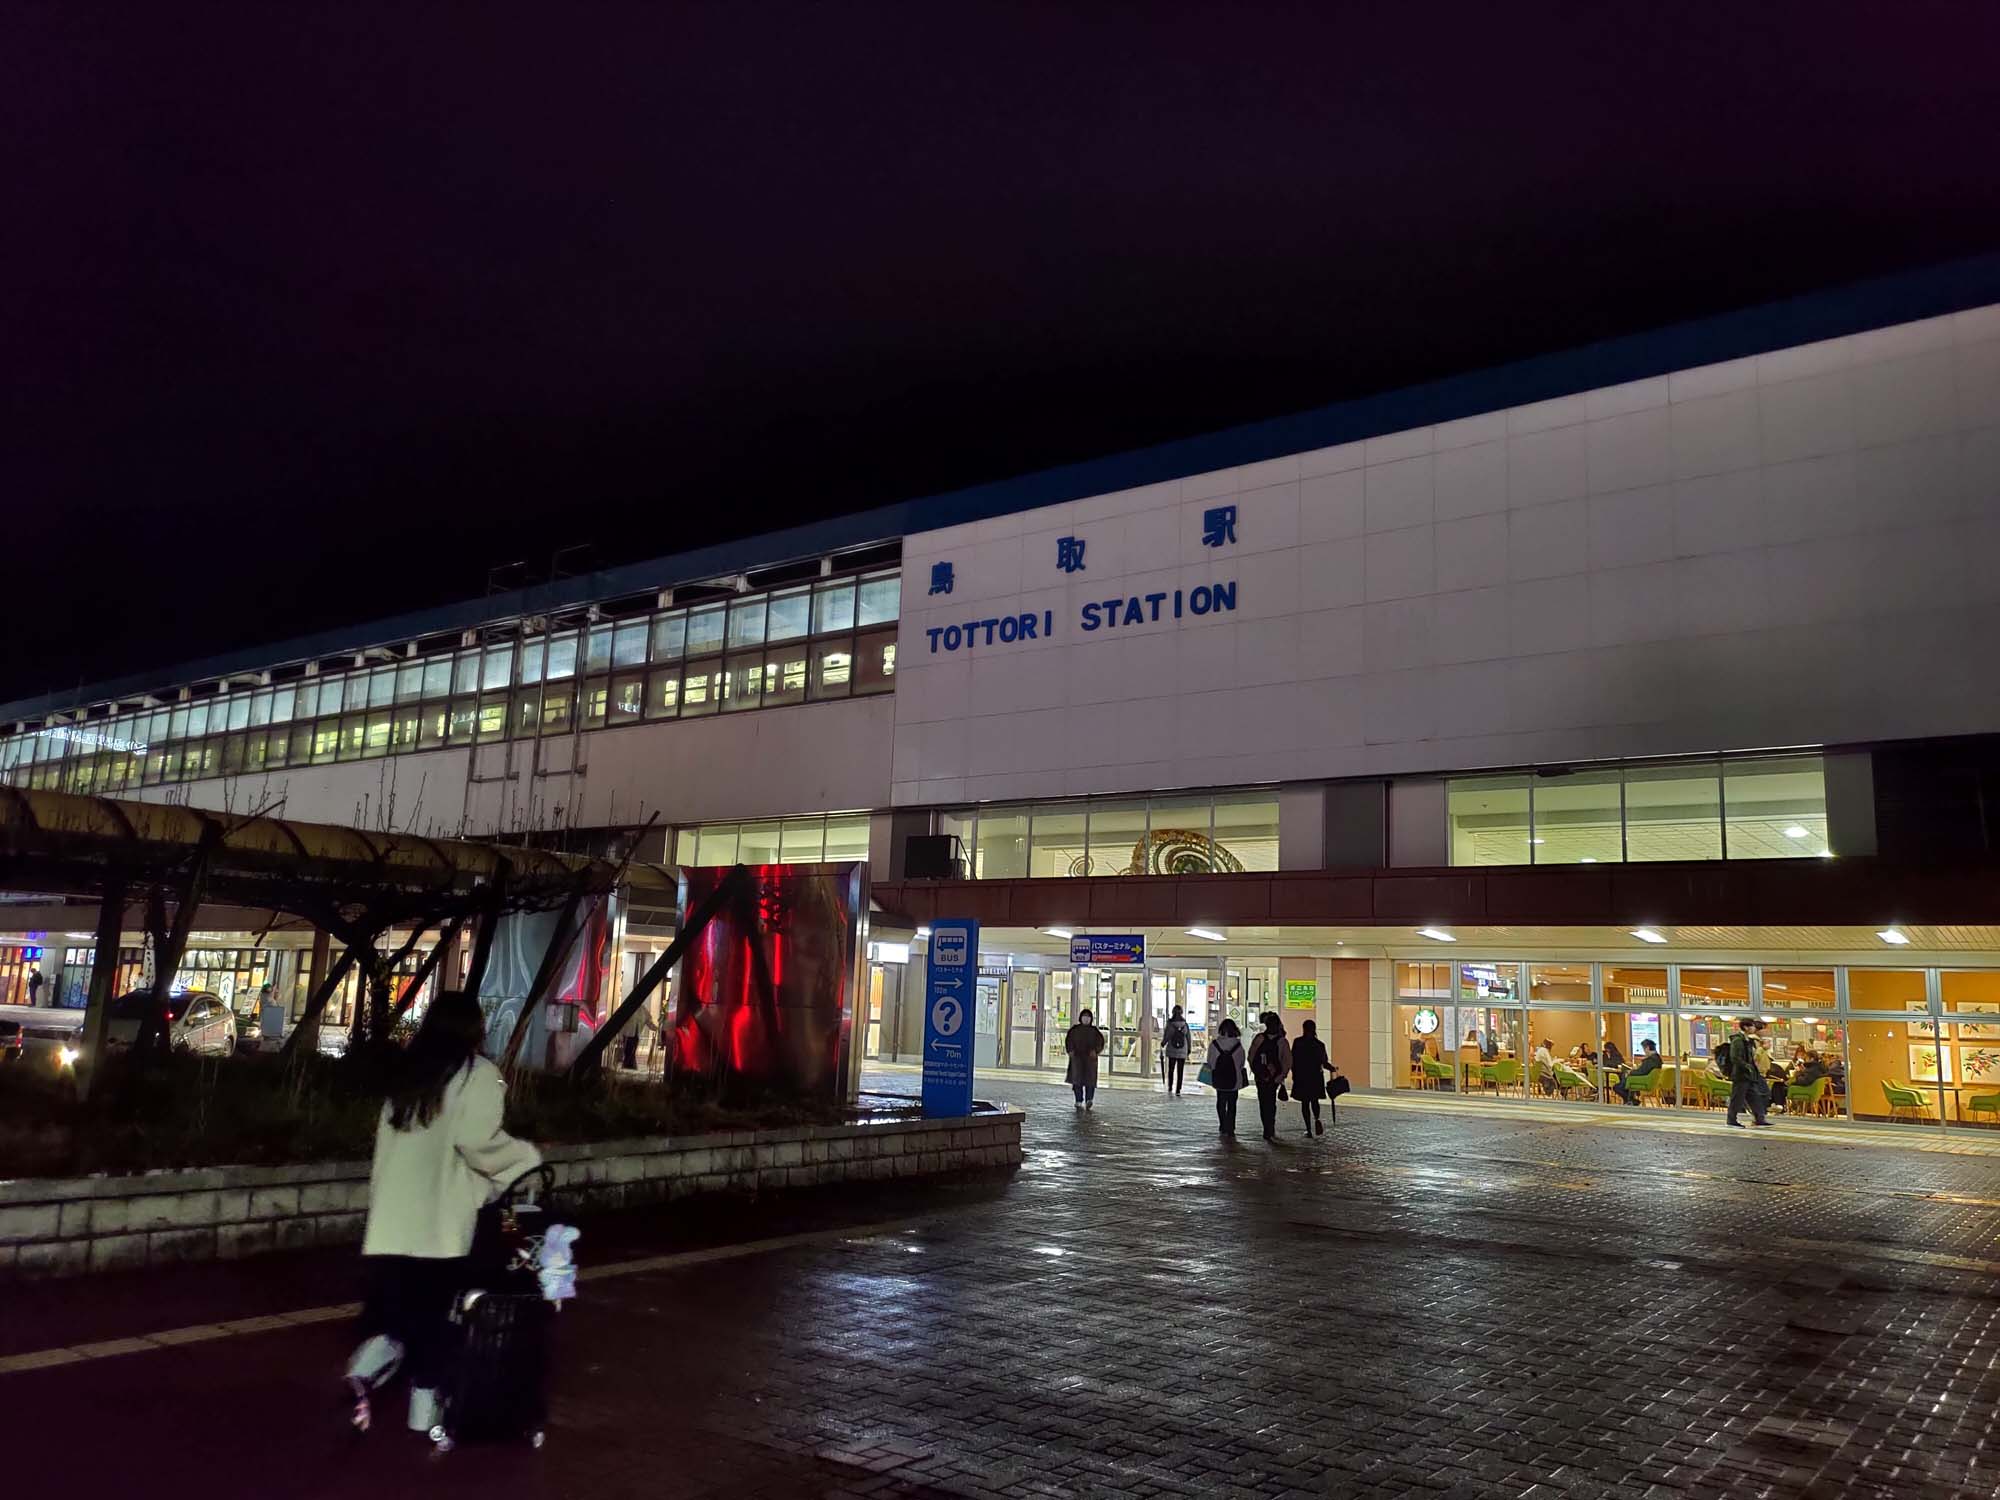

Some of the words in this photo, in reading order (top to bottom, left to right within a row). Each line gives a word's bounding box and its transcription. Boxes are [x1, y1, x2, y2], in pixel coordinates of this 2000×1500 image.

[928, 505, 1237, 596] 鳥取駅
[926, 611, 1052, 654] TOTTORI
[1081, 581, 1237, 631] STATION
[940, 954, 959, 962] BUS
[945, 1050, 962, 1060] 70m
